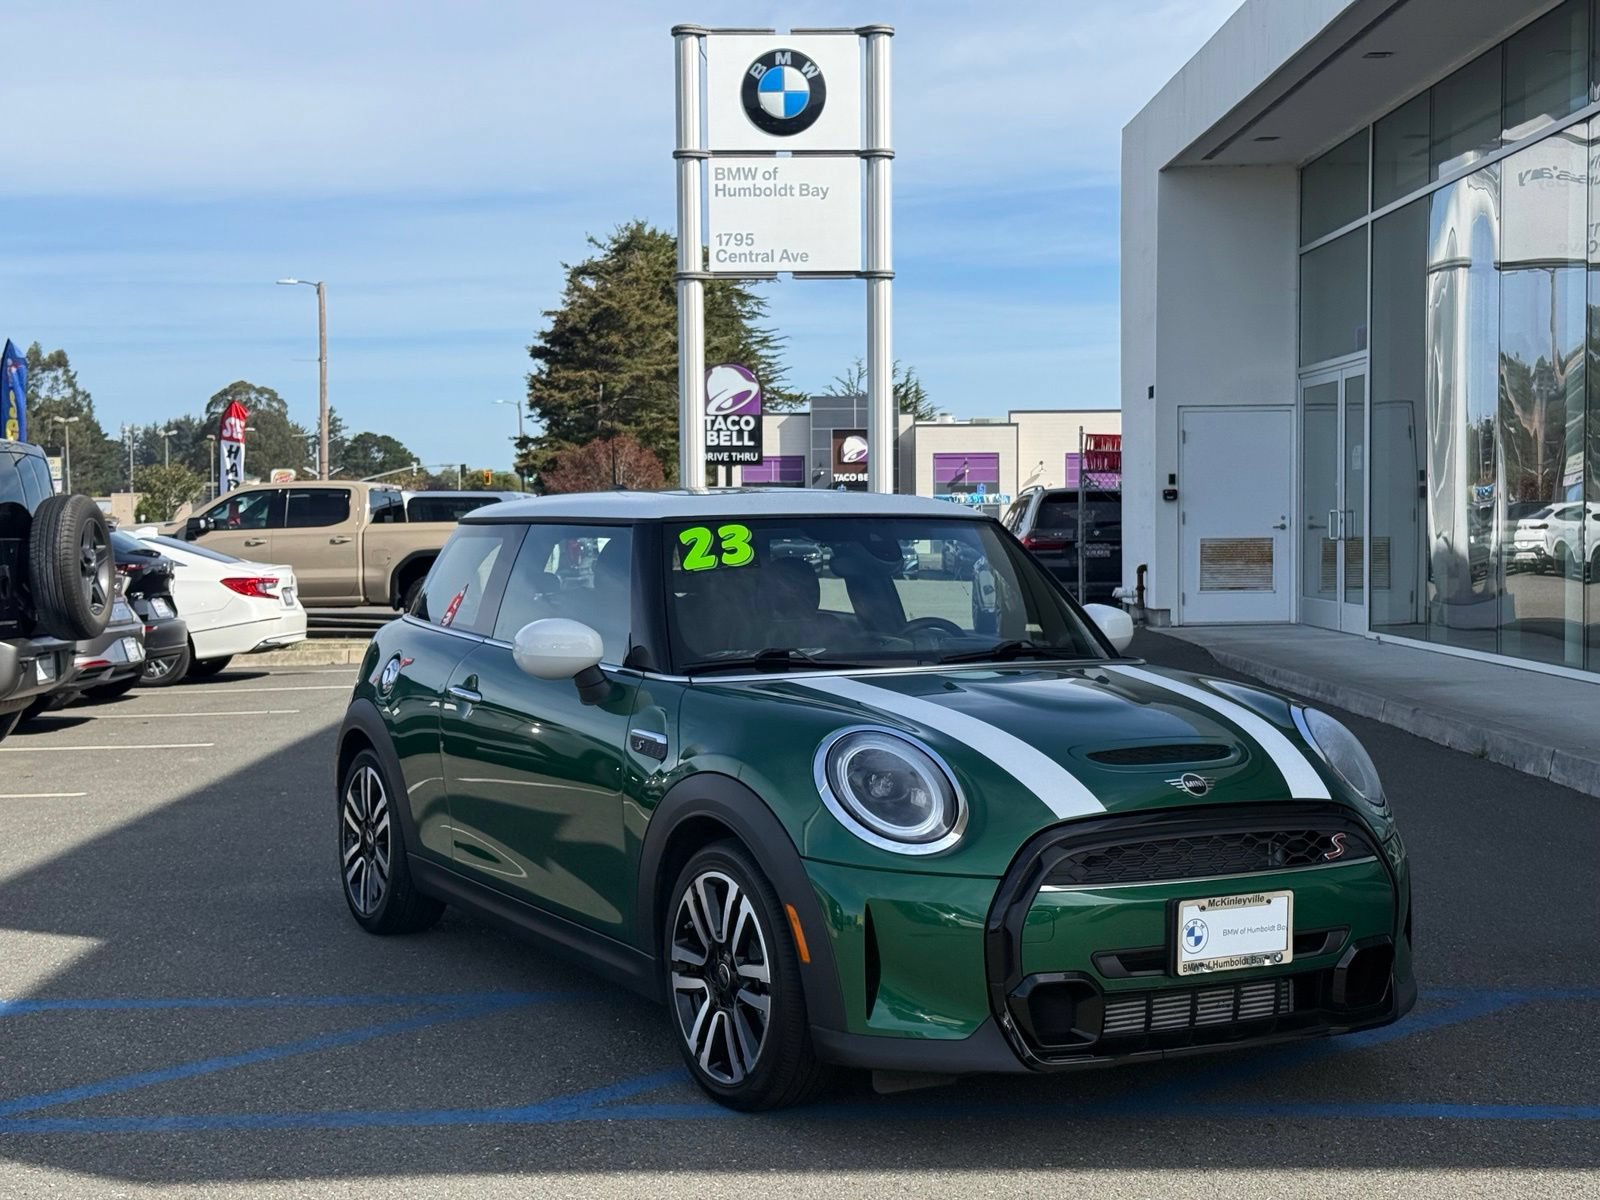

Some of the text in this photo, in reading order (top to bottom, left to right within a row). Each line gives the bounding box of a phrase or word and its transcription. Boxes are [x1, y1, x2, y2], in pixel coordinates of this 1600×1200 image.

[749, 52, 819, 79] BMW
[714, 167, 779, 181] BMW of
[714, 184, 829, 200] Humboldt Bay
[715, 233, 754, 247] 1795
[715, 249, 809, 263] Central Ave
[704, 415, 755, 431] TACO
[706, 430, 755, 446] BELL
[731, 452, 758, 462] THRU
[833, 473, 857, 482] TACO
[679, 524, 755, 572] 23
[1207, 895, 1265, 908] McKinleyville
[1222, 929, 1239, 937] BMW
[1247, 925, 1275, 934] Humboldt
[1212, 957, 1249, 970] Humboldt
